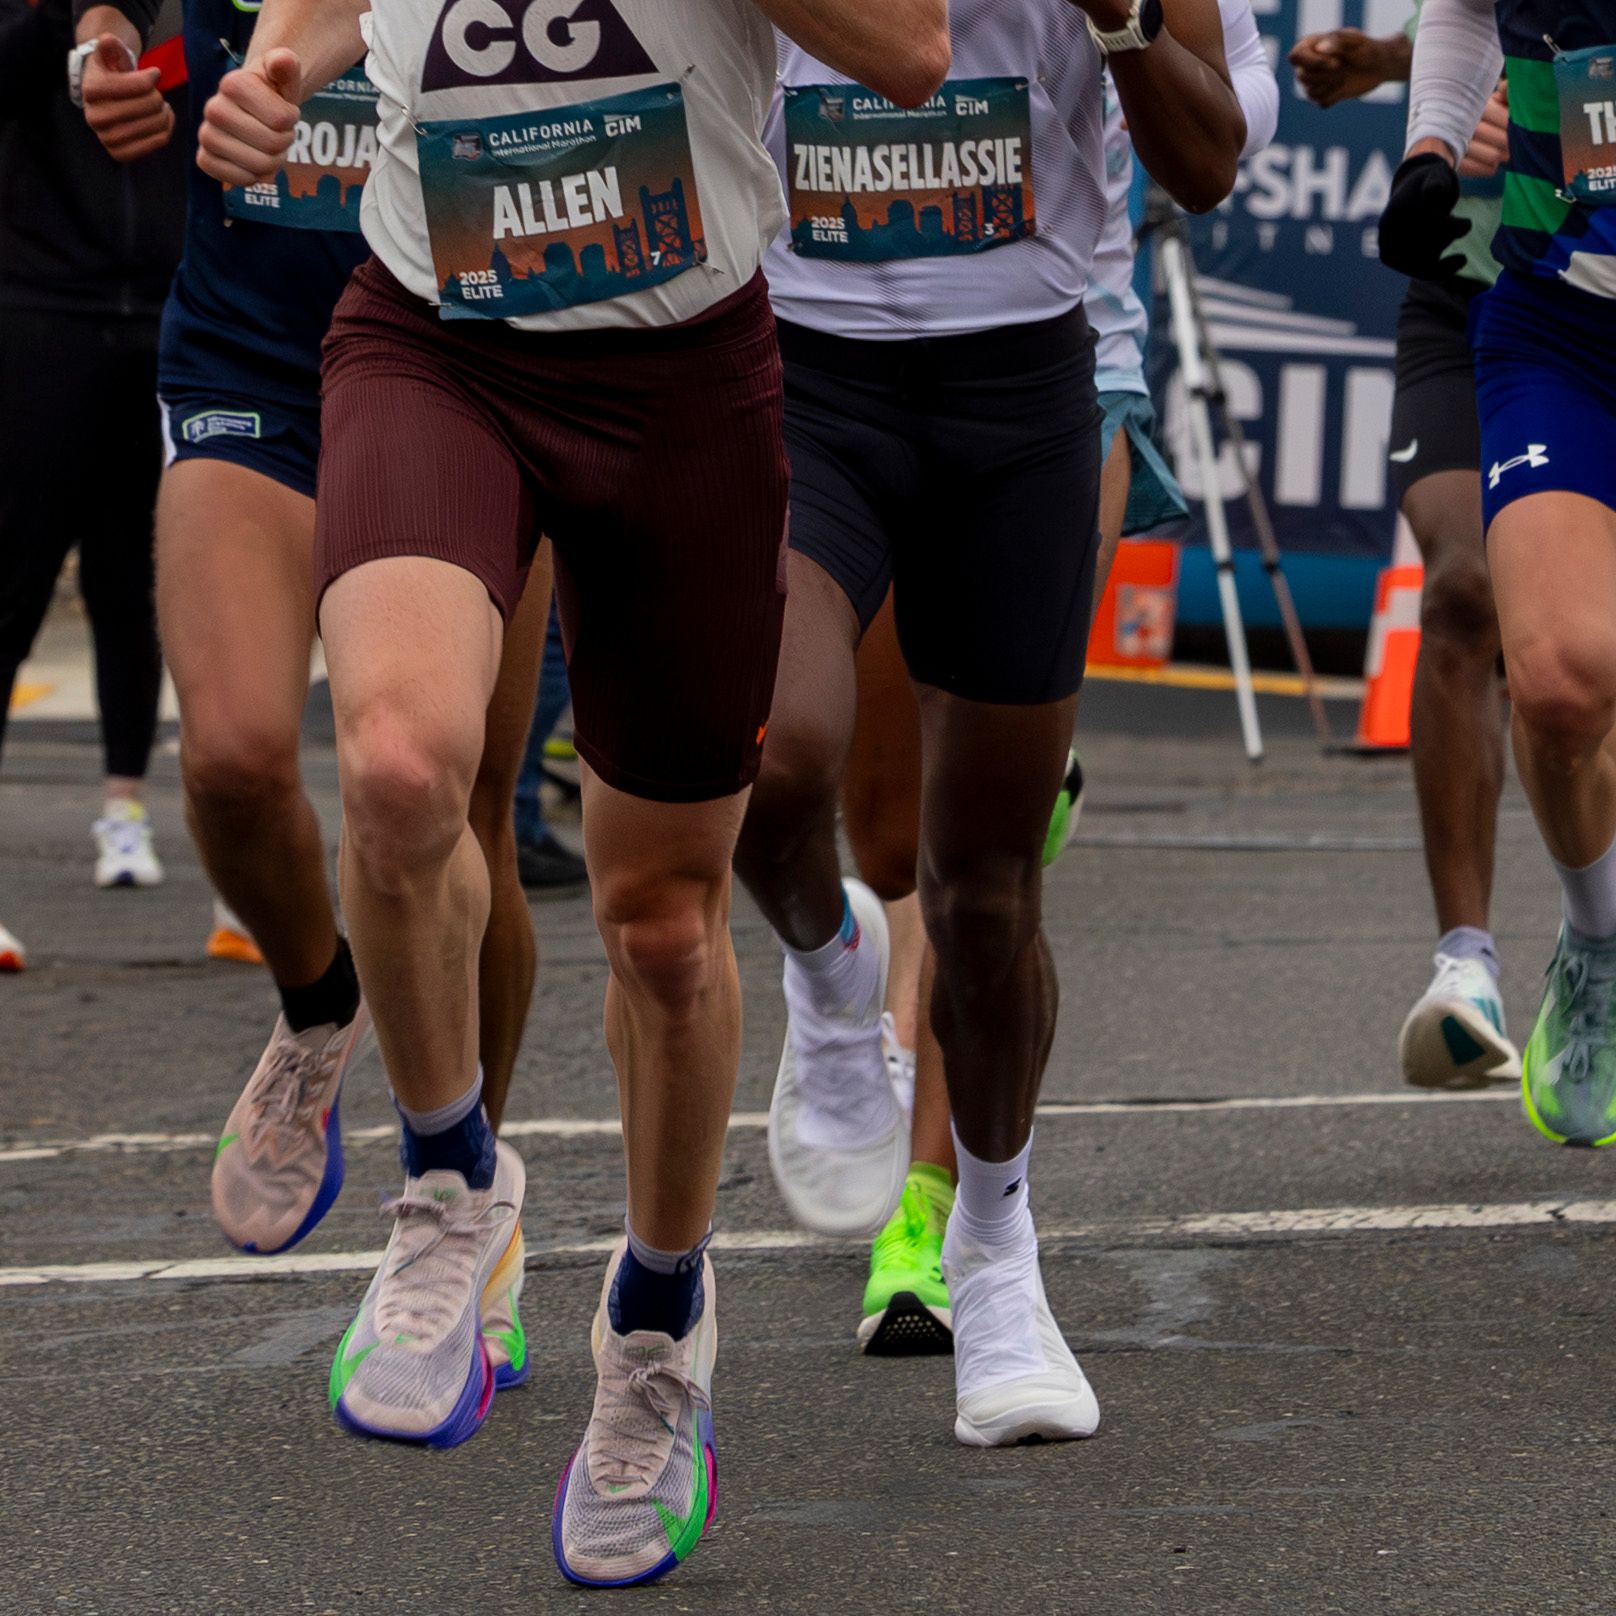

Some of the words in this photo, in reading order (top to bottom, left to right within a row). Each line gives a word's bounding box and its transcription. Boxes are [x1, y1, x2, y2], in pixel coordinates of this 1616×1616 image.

[956, 100, 989, 116] CIM
[489, 119, 593, 147] CALIFORNIA
[605, 115, 642, 137] CIM
[287, 120, 381, 169] ROJA
[551, 135, 597, 150] Marathon
[793, 137, 1023, 193] ZIENASELLASSIE
[244, 193, 280, 208] ELITE
[493, 166, 624, 239] ALLEN
[811, 216, 846, 230] 2025
[984, 223, 994, 235] 3
[812, 230, 849, 244] ELITE
[459, 270, 498, 286] 2025
[650, 251, 661, 266] 7
[461, 284, 504, 300] ELITE
